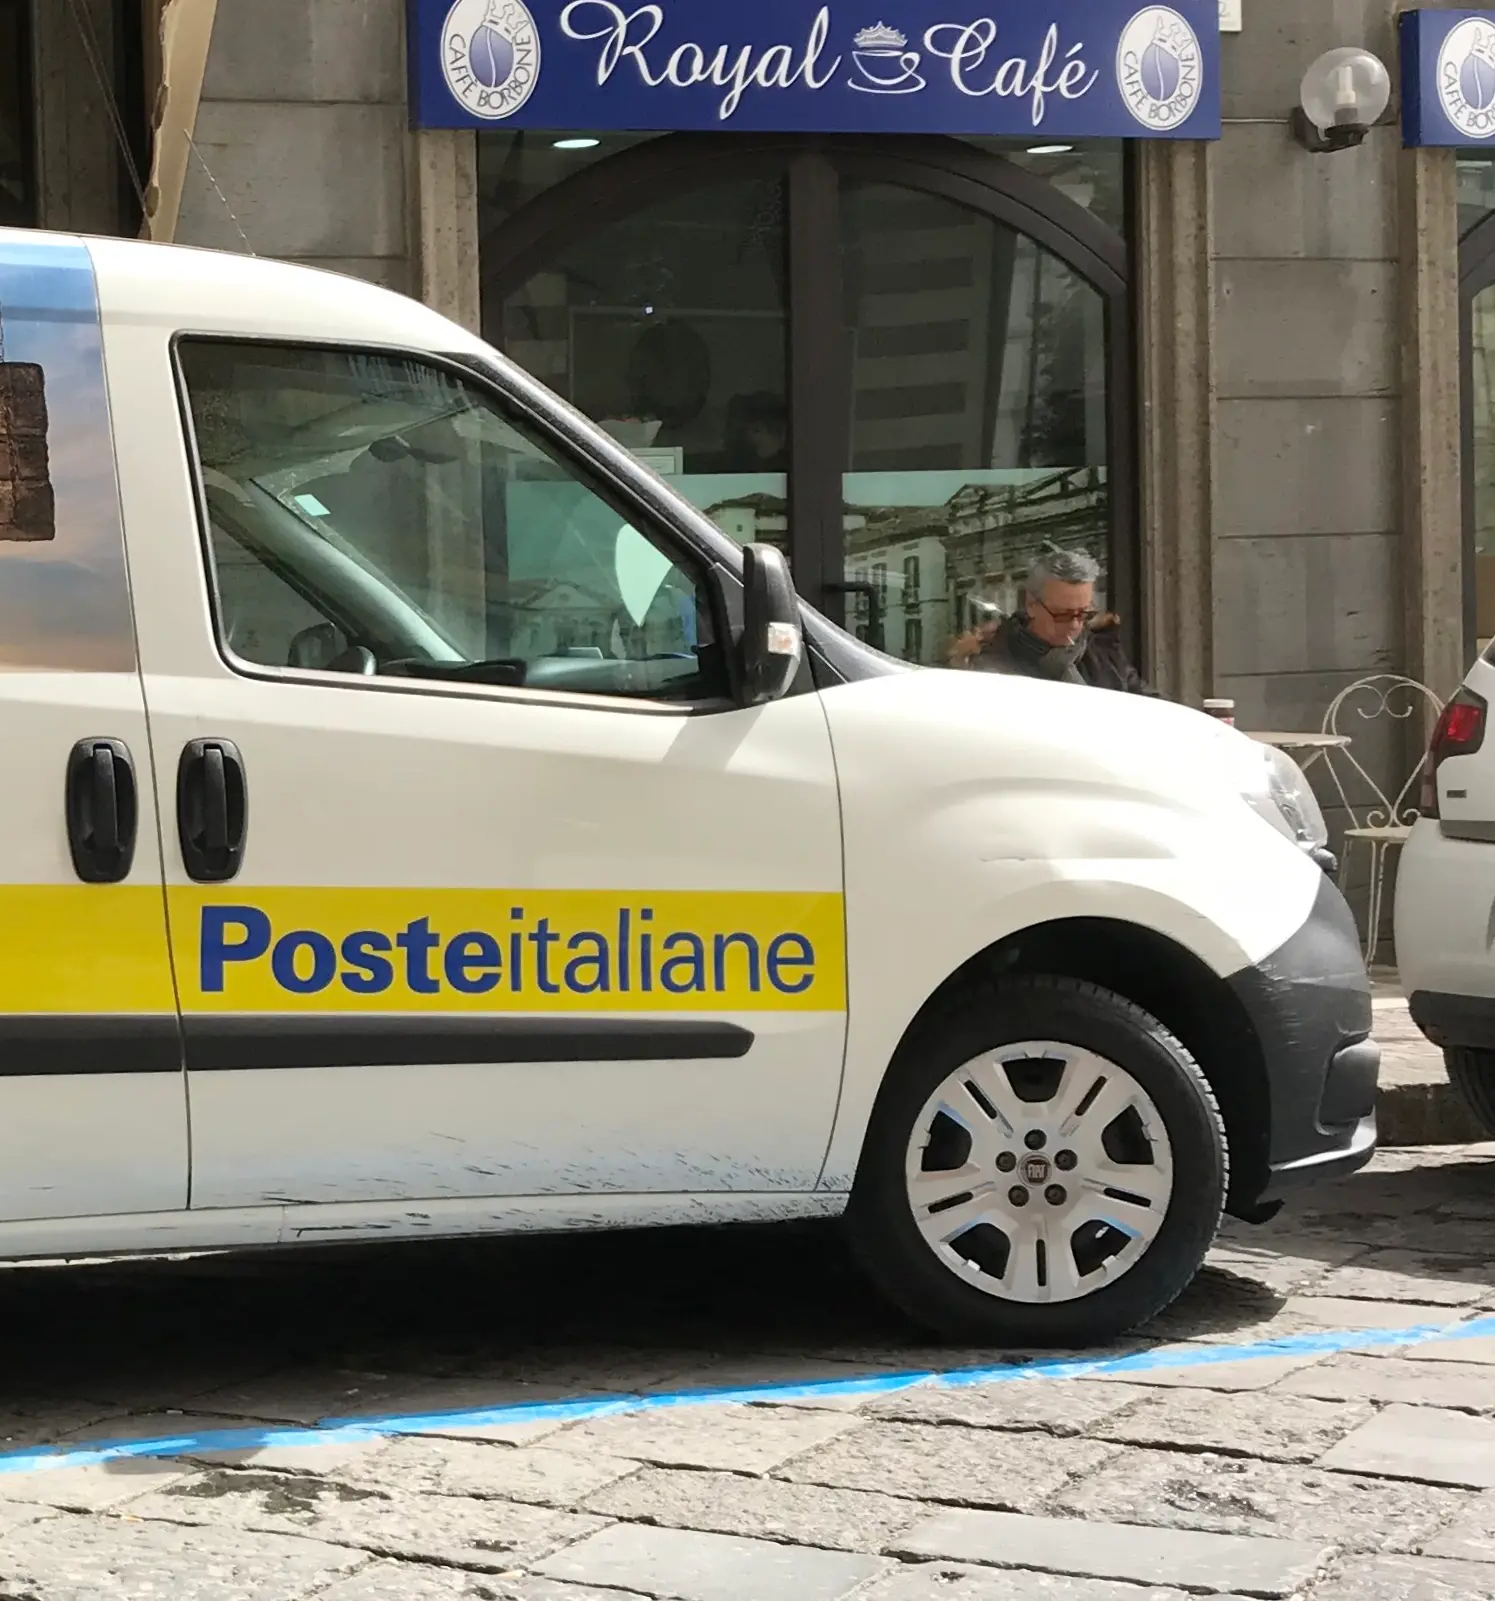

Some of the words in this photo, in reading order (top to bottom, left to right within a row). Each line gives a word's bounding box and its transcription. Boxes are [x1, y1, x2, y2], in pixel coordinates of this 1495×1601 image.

[477, 35, 533, 110] BORBONE
[560, 0, 842, 120] Royal
[923, 18, 1100, 127] Café
[1147, 52, 1196, 122] BORBONE
